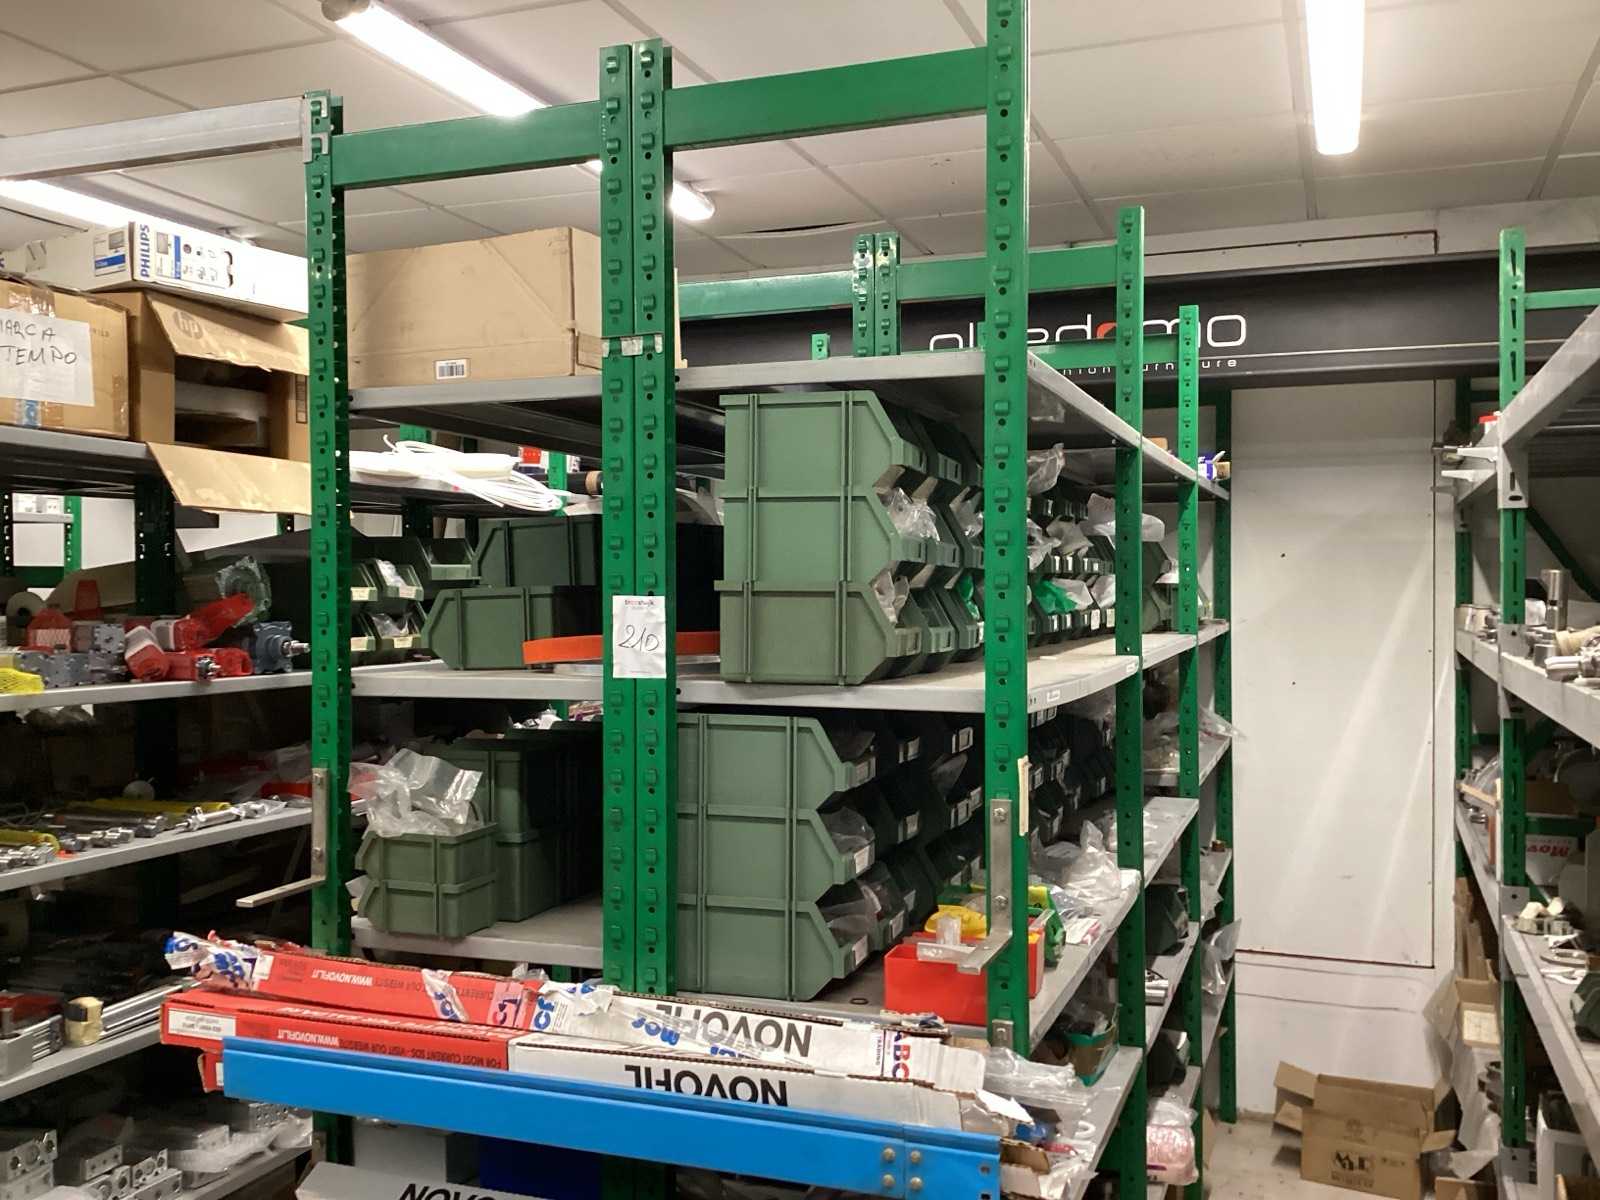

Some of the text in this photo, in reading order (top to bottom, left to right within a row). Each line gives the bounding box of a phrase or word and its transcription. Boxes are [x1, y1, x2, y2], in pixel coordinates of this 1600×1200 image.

[139, 223, 151, 278] PHILIPS
[618, 624, 660, 652] 210
[624, 1064, 788, 1107] NOVOFIL
